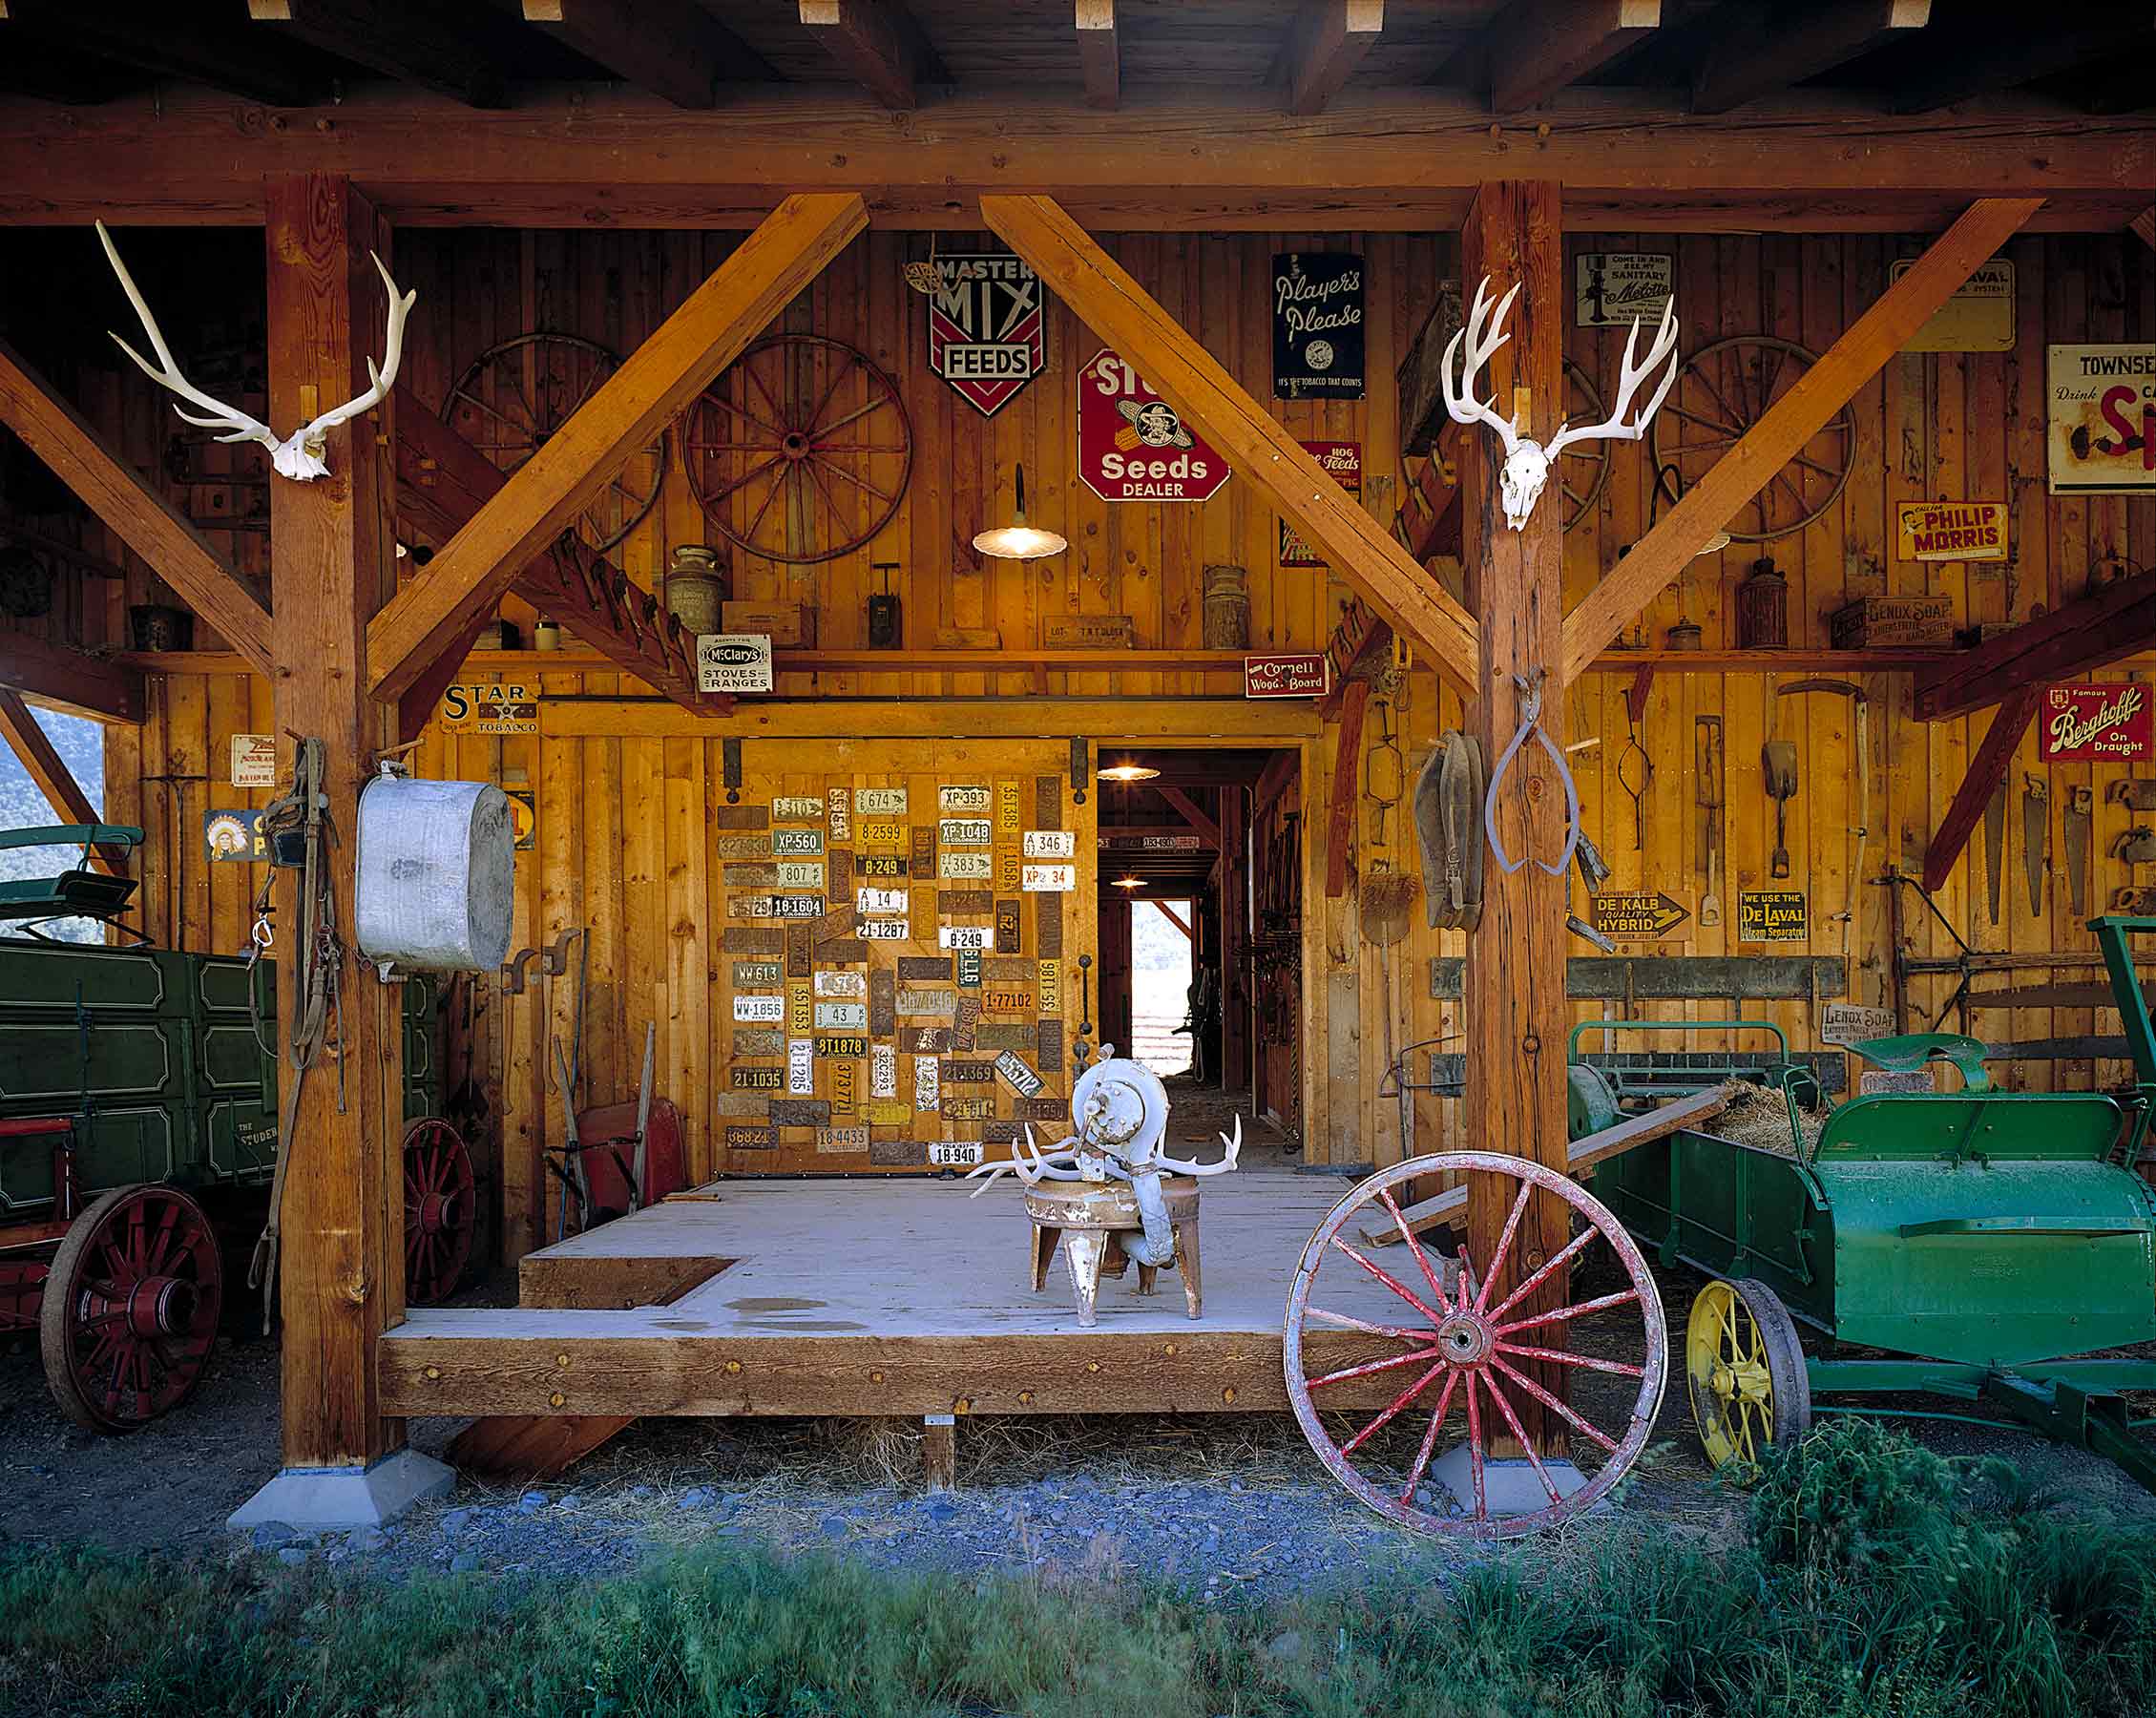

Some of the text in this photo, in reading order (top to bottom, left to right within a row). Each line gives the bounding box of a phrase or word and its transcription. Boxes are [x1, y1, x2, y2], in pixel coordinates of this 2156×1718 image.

[936, 261, 1035, 279] MASTER
[1611, 270, 1666, 280] SANITARY
[1276, 270, 1360, 314] Player's
[937, 282, 1035, 340] MIX
[1287, 304, 1361, 343] Please
[950, 349, 1028, 374] FEEDS
[2056, 386, 2098, 401] Drink
[1331, 448, 1353, 456] HOG
[1101, 452, 1207, 479] Seeds
[1122, 483, 1183, 496] DEALER
[1924, 507, 1996, 530] PHILIP
[1914, 527, 1999, 552] MORRIS
[711, 648, 758, 661] McClary's
[703, 669, 757, 678] STOVES
[1264, 662, 1313, 677] Cornell
[711, 679, 767, 687] RANGES
[1289, 678, 1322, 690] Board
[444, 686, 524, 720] STAR
[2050, 687, 2143, 753] Berghoff
[478, 723, 536, 732] TOBACCO
[2109, 732, 2127, 742] On
[2094, 742, 2143, 756] Draught
[869, 794, 889, 807] 674
[1039, 837, 1060, 850] 346
[954, 858, 974, 871] 383
[785, 868, 807, 880] 807
[1026, 870, 1065, 883] XP 34
[877, 893, 890, 906] 14
[1598, 898, 1659, 911] DE KALB
[1744, 894, 1801, 903] WE USE THE
[1605, 911, 1649, 919] QUALITY
[1598, 918, 1653, 931] HYBRID
[832, 1009, 848, 1021] 43
[1825, 1005, 1862, 1024] LENOX
[238, 1122, 252, 1131] THE
